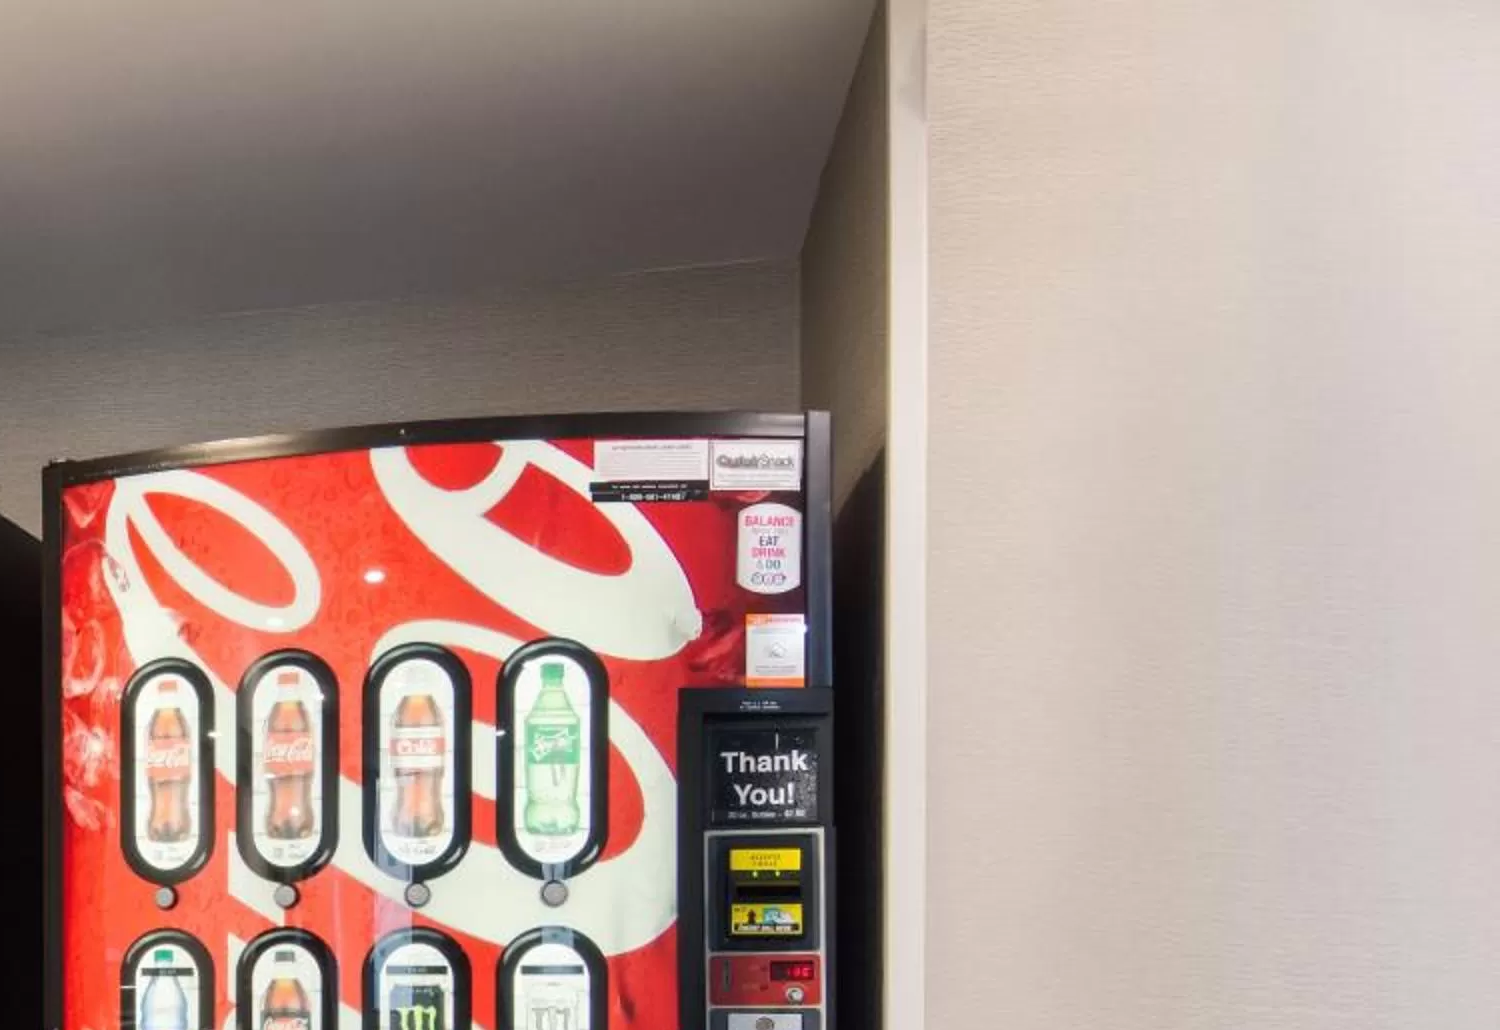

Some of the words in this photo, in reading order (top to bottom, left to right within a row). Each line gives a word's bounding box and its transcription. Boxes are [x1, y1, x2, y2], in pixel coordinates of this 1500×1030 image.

[745, 515, 795, 527] BALANCE
[759, 535, 780, 547] EAT
[720, 749, 809, 773] Thank
[733, 782, 794, 806] You!
